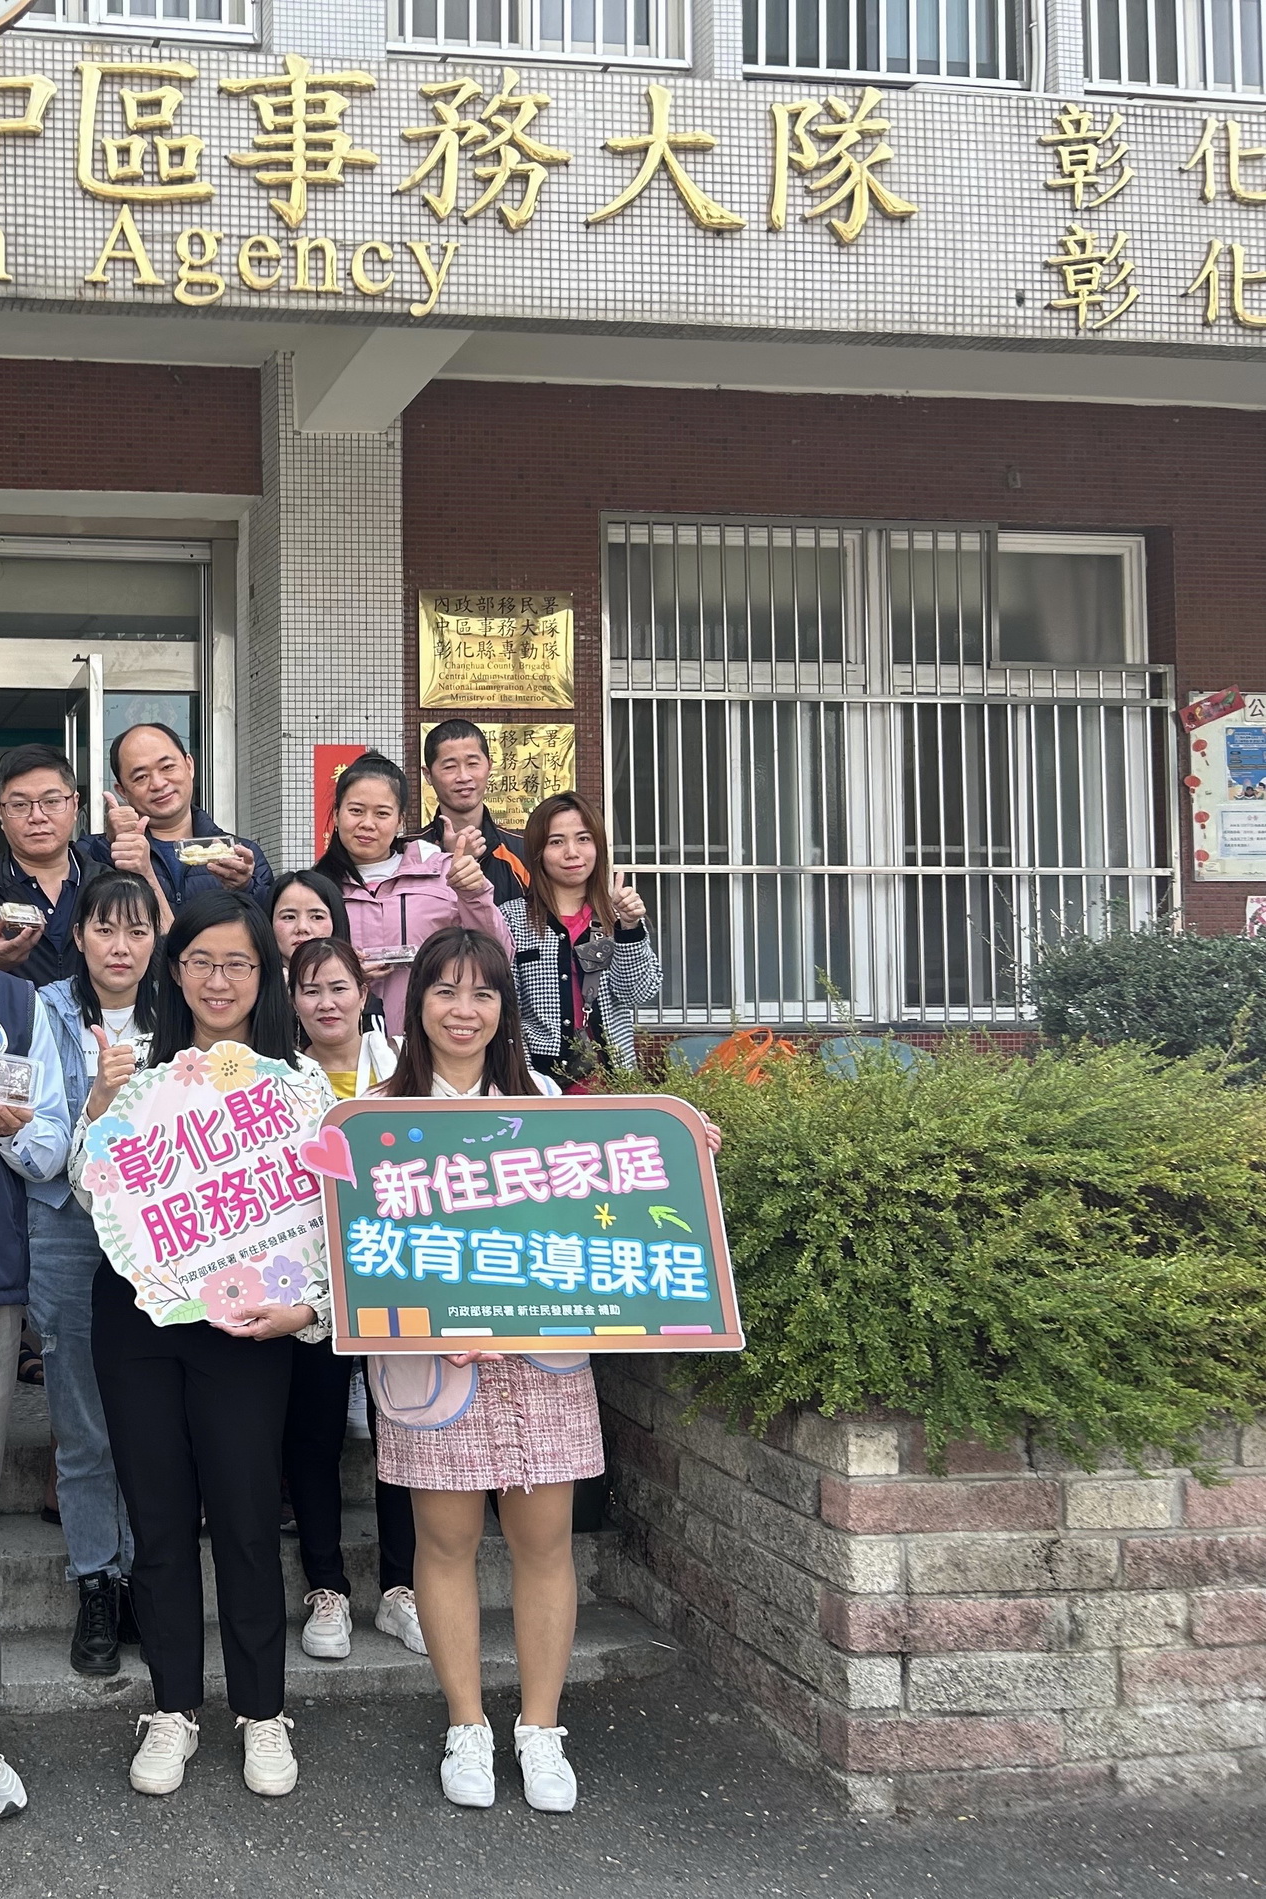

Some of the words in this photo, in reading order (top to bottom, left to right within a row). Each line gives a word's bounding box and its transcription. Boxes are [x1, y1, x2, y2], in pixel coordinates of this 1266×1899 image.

[85, 203, 461, 317] Agency
[433, 596, 560, 615] 內政部移民署
[434, 617, 561, 638] 中區事務大隊
[433, 639, 561, 660] 彰化縣專勤隊
[444, 661, 485, 671] Changhua
[487, 661, 515, 671] County
[438, 672, 468, 680] Central
[470, 672, 532, 681] Administration
[438, 683, 472, 691] National
[475, 683, 524, 692] Immigration
[526, 683, 556, 693] Agency
[450, 693, 485, 703] Ministry
[487, 693, 496, 702] of
[499, 693, 513, 702] the
[515, 693, 545, 702] Interior
[1248, 698, 1266, 717] 公
[110, 1077, 294, 1194] 彰化縣
[372, 1135, 669, 1218] 新住民家庭
[141, 1146, 321, 1263] 服務站
[348, 1217, 709, 1300] 教育宣導課程
[517, 1304, 596, 1317] 新住民發展基金
[598, 1304, 621, 1316] 補助
